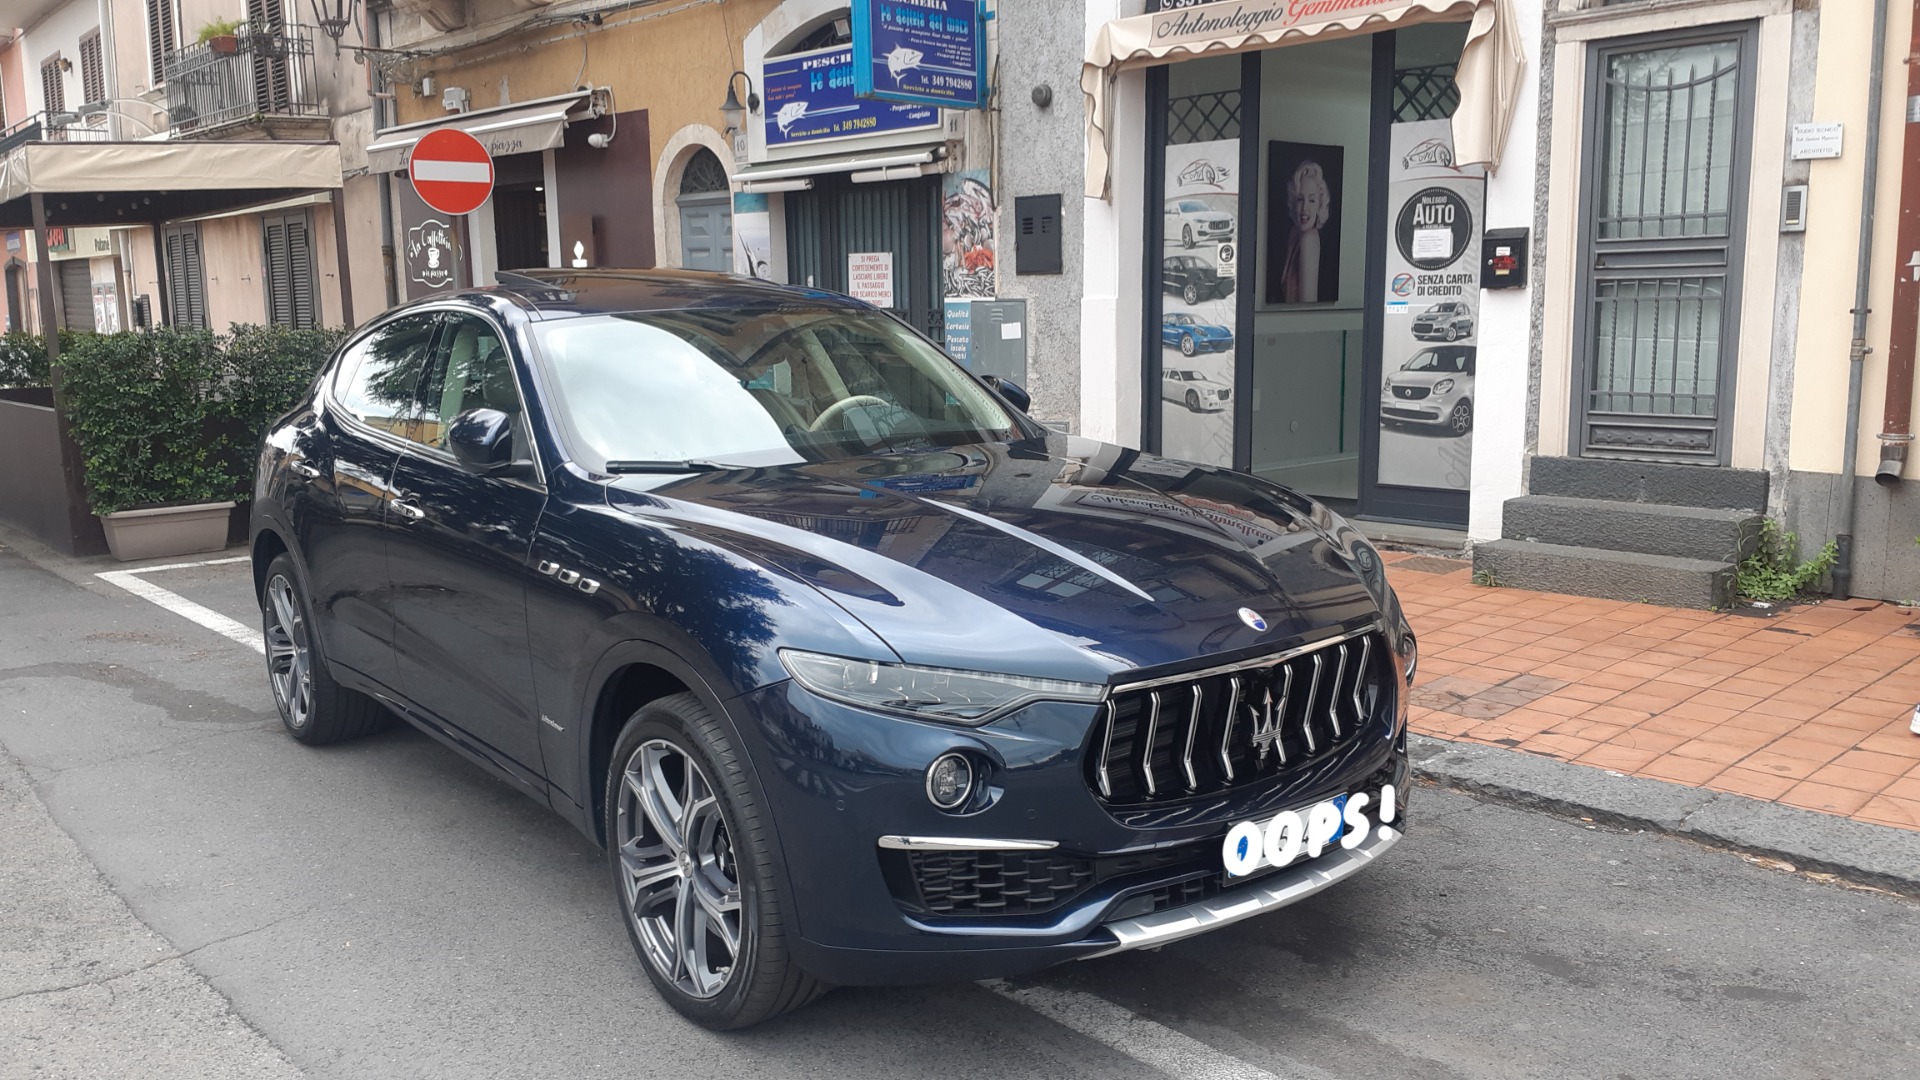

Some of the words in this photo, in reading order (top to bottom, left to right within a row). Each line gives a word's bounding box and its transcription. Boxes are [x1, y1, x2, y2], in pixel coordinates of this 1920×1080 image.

[1157, 2, 1283, 39] Autonoleggio
[802, 53, 852, 70] PESCH
[932, 75, 944, 87] 349
[945, 77, 973, 90] 7942880
[903, 84, 924, 93] Servizio
[930, 87, 955, 96] domicilio
[842, 120, 852, 131] 349
[491, 137, 523, 155] piazza
[737, 139, 746, 151] 10
[1422, 196, 1447, 204] NOLEGGIO
[1412, 203, 1455, 225] AUTO
[1417, 274, 1444, 285] SENZA
[1446, 273, 1473, 284] CARTA
[860, 290, 877, 298] SCARICO
[878, 290, 891, 298] MERCI
[1417, 286, 1426, 296] DI
[1427, 285, 1462, 296] CREDITO
[947, 335, 969, 343] Pescato
[951, 344, 966, 352] locale
